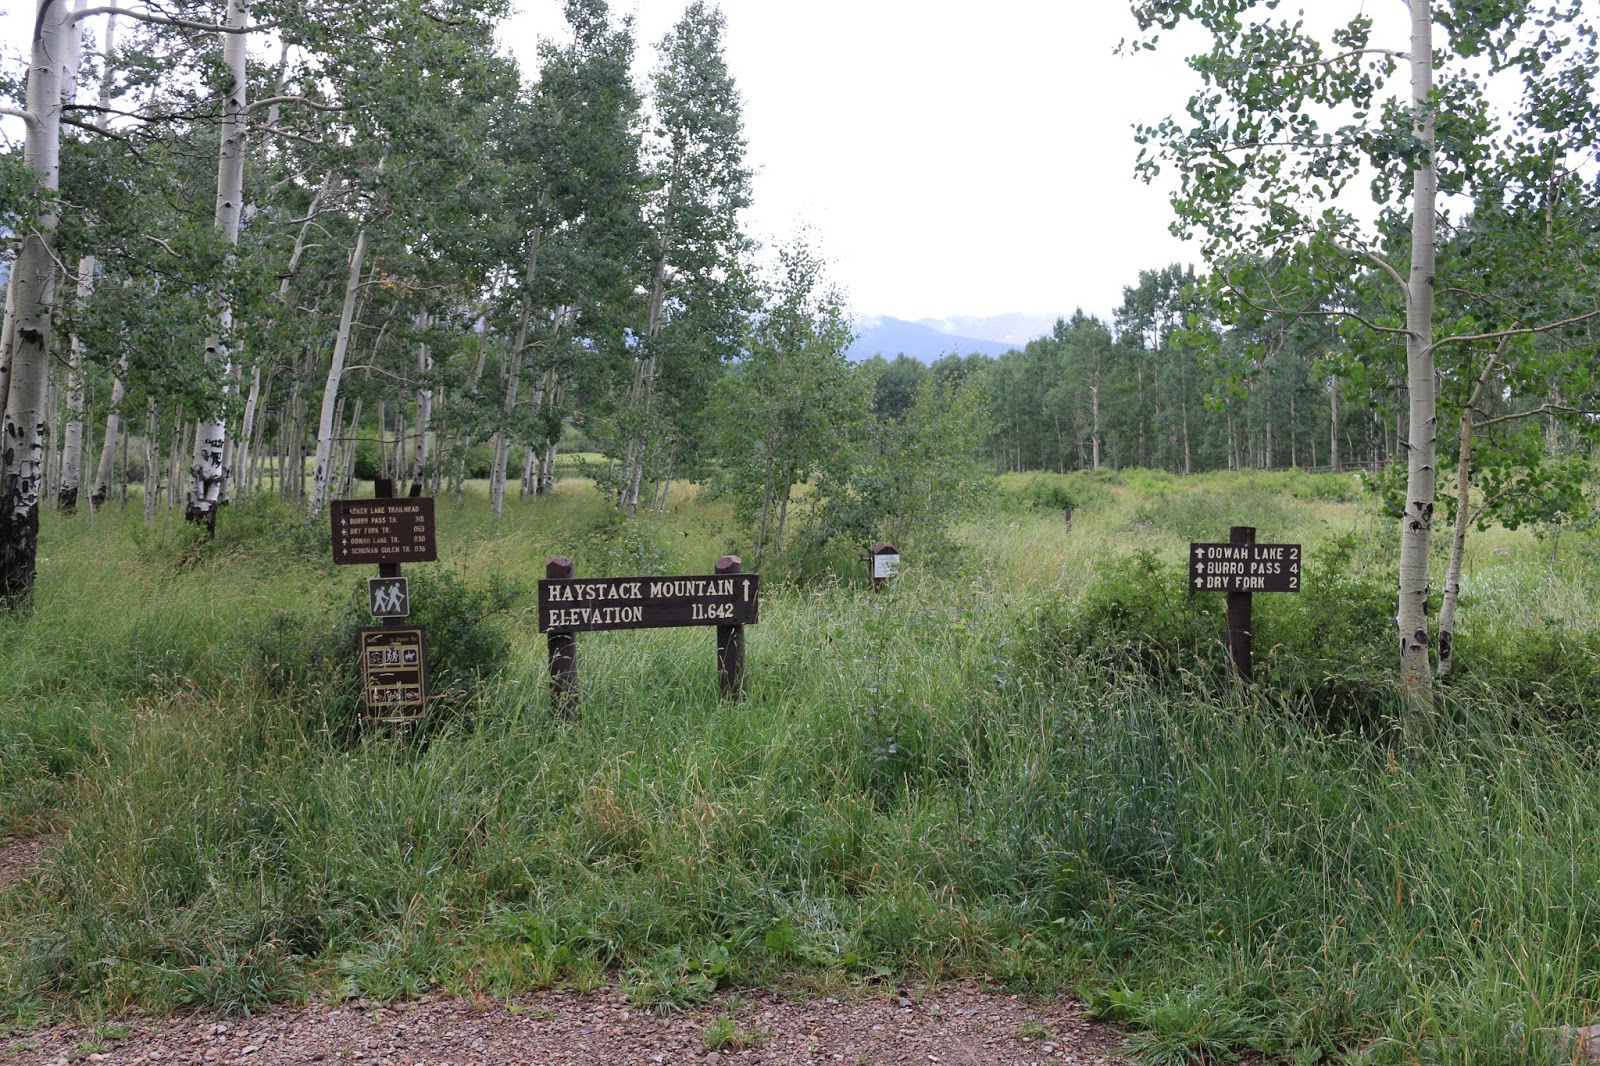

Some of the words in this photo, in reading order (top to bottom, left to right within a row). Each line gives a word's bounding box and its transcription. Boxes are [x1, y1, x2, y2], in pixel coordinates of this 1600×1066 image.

[415, 515, 425, 523] 315
[364, 527, 379, 535] FORK
[413, 535, 426, 543] 030
[1208, 547, 1249, 560] OOWAH
[1254, 548, 1284, 560] LAKE
[1289, 548, 1298, 560] 2
[1207, 561, 1245, 575] BURRO
[1250, 562, 1281, 575] PASS
[1289, 562, 1299, 575] 4
[1206, 576, 1230, 589] DRY
[1235, 576, 1265, 589] FORK
[1288, 576, 1298, 589] 2
[548, 583, 643, 602] HAYSTACK
[650, 579, 734, 598] MOUNTAIN
[548, 606, 643, 627] ELEVATION
[691, 603, 734, 620] 11,642
